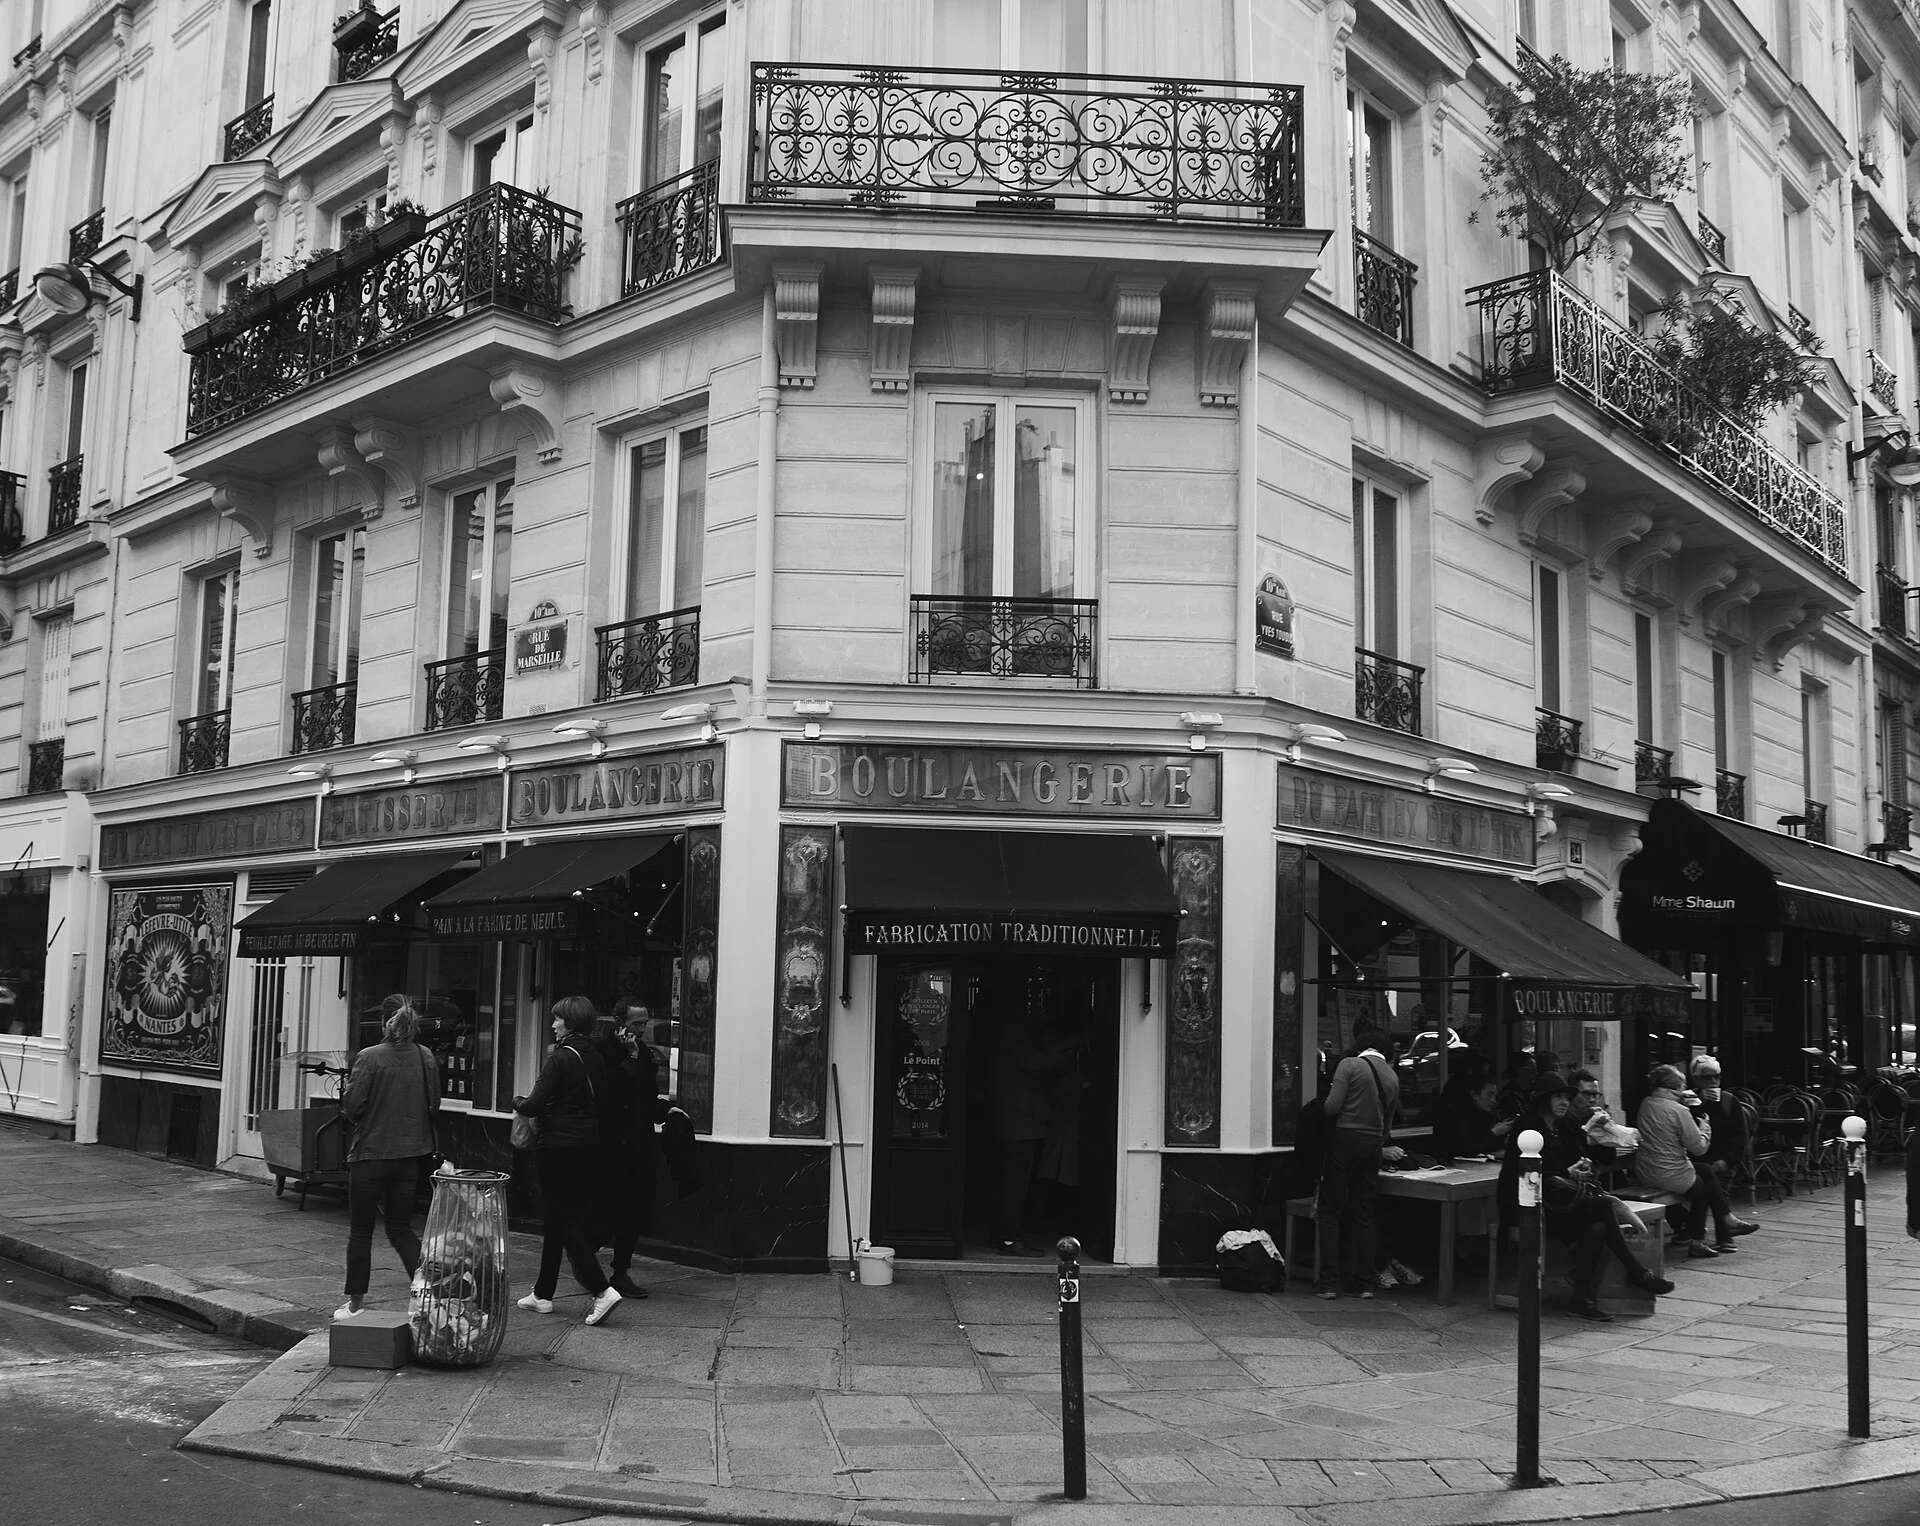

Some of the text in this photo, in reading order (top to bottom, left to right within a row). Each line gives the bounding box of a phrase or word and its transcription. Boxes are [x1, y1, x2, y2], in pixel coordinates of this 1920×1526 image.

[1271, 610, 1284, 624] RUE
[532, 630, 549, 643] RUE
[1260, 624, 1275, 638] YVES
[534, 642, 546, 654] DE
[518, 651, 560, 668] MARSEILLE
[520, 759, 714, 817] BOULANGERIE
[810, 754, 1193, 807] BOULANGERIE
[1293, 777, 1323, 821] DU
[1652, 895, 1736, 909] Mme Shawn
[433, 917, 453, 934] PAIN
[464, 916, 475, 932] LA
[478, 914, 512, 932] FARINE
[514, 914, 528, 931] DE
[530, 911, 566, 930] MEULE
[305, 932, 340, 949] BEURRE
[341, 932, 358, 948] FIN
[864, 922, 1162, 948] FABRICATION TRADITIONNELLE
[1513, 989, 1616, 1015] BOULANGERIE
[144, 1017, 177, 1032] NANTES
[903, 1056, 941, 1065] Le Point
[911, 1121, 929, 1129] 2014
